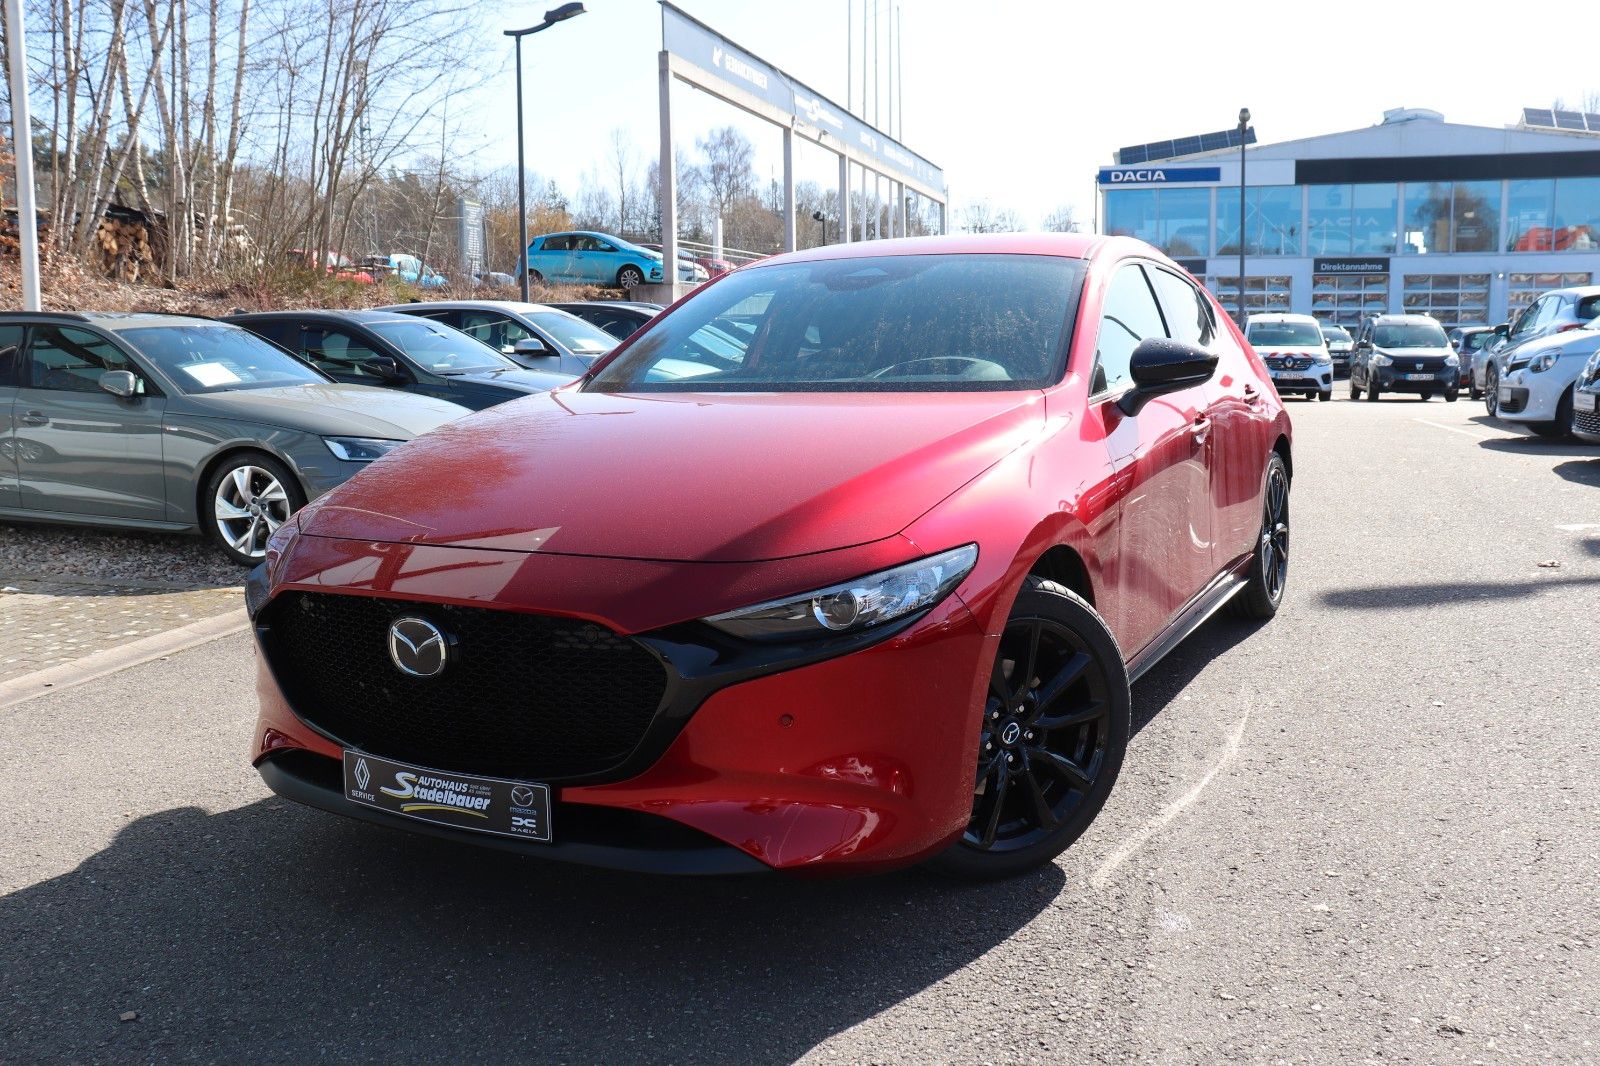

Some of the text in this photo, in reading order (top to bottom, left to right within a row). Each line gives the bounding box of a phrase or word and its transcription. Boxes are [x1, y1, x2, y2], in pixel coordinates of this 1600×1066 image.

[1110, 169, 1166, 182] DACIA
[1320, 261, 1383, 271] Direktannahme
[379, 771, 491, 810] Stadelbauer
[417, 776, 469, 793] AUTOHAUS
[351, 789, 376, 802] SERVICE
